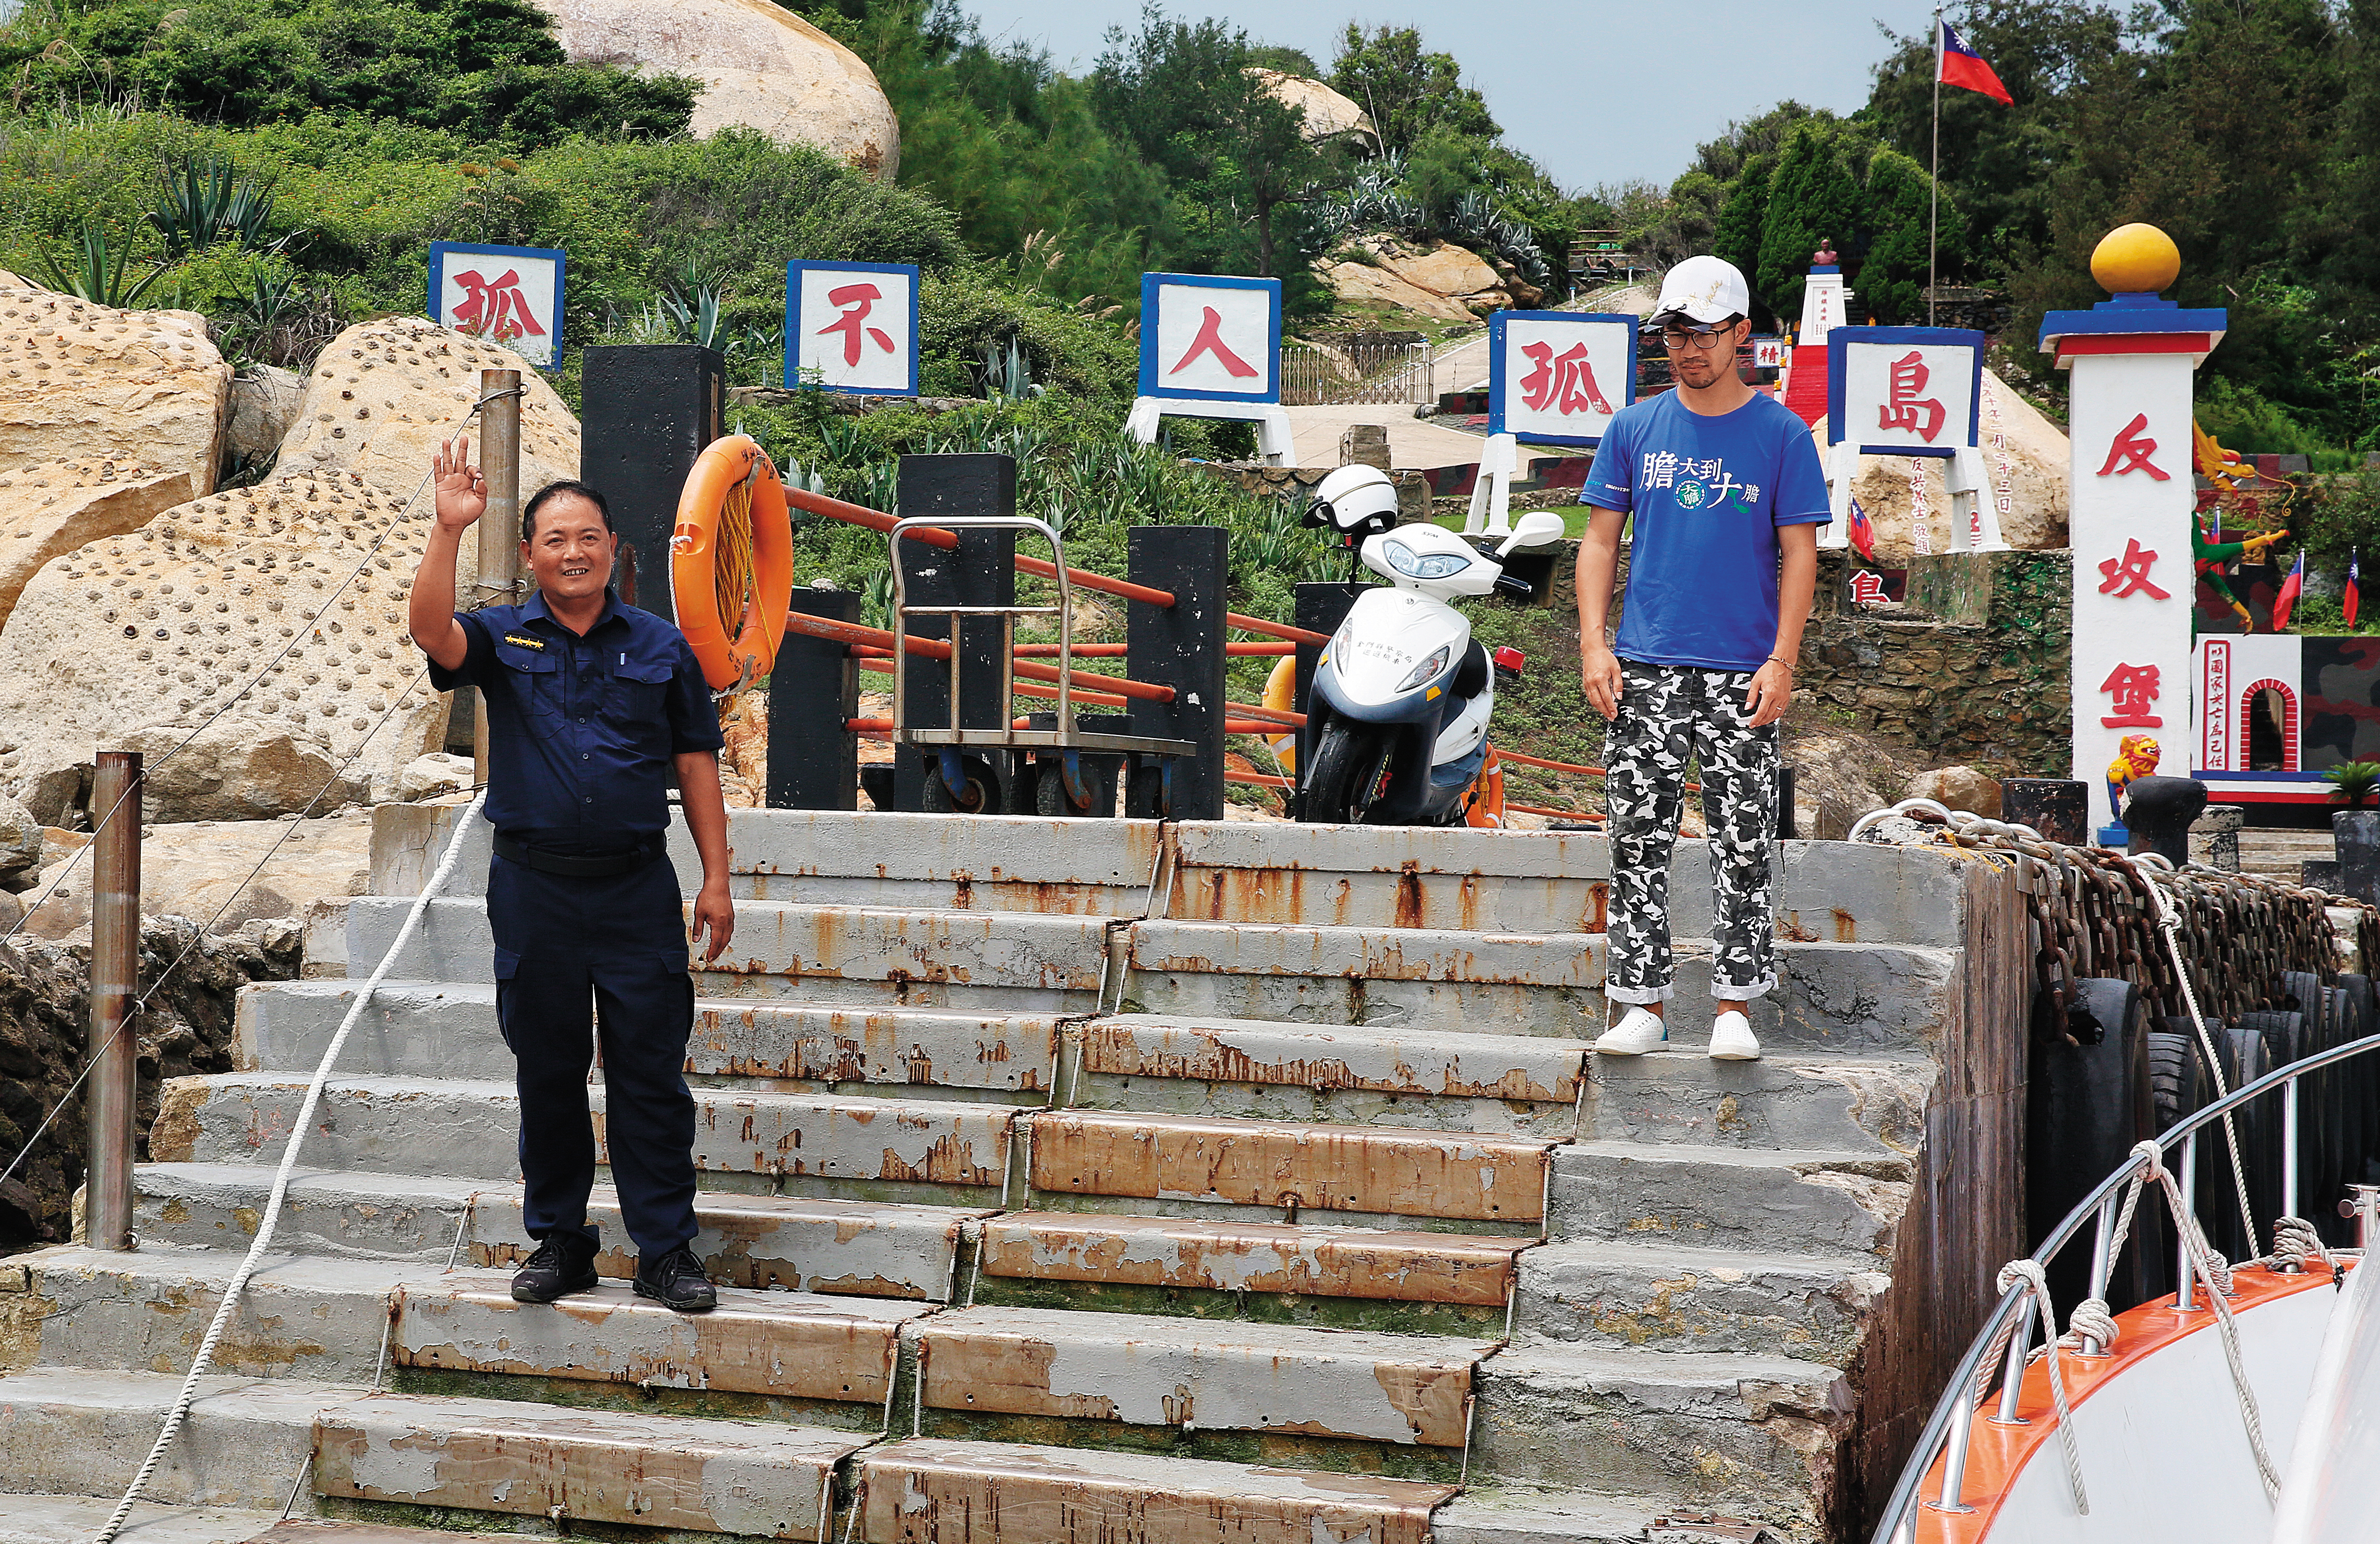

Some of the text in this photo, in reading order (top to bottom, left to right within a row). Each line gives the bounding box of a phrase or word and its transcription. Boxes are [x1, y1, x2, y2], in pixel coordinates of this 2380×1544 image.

[452, 269, 547, 340] 孤
[816, 283, 895, 367] 不
[1169, 306, 1259, 378] 人
[1520, 340, 1613, 416] 孤
[1759, 345, 1779, 364] 精
[1879, 350, 1947, 443] 島
[2096, 412, 2171, 729] 反攻堡
